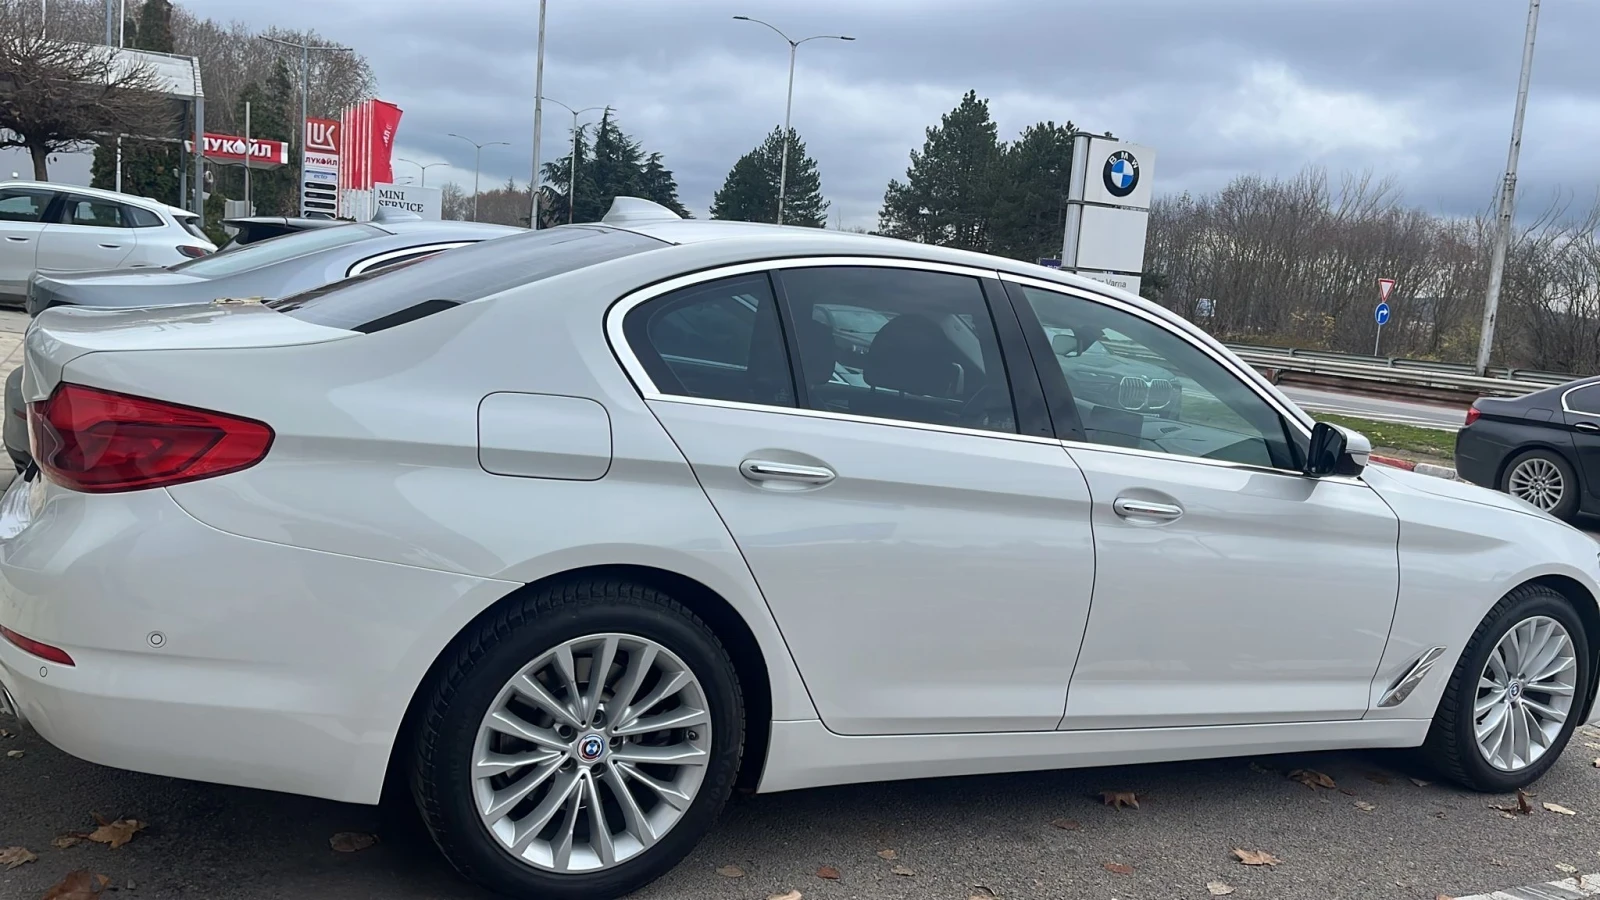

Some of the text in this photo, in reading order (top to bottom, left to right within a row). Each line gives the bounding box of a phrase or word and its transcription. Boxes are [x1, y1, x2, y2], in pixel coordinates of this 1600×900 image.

[307, 122, 336, 151] LUK
[1108, 151, 1138, 169] BMW
[379, 189, 405, 201] MINI
[378, 199, 424, 213] SERVICE
[1105, 278, 1127, 288] Varna
